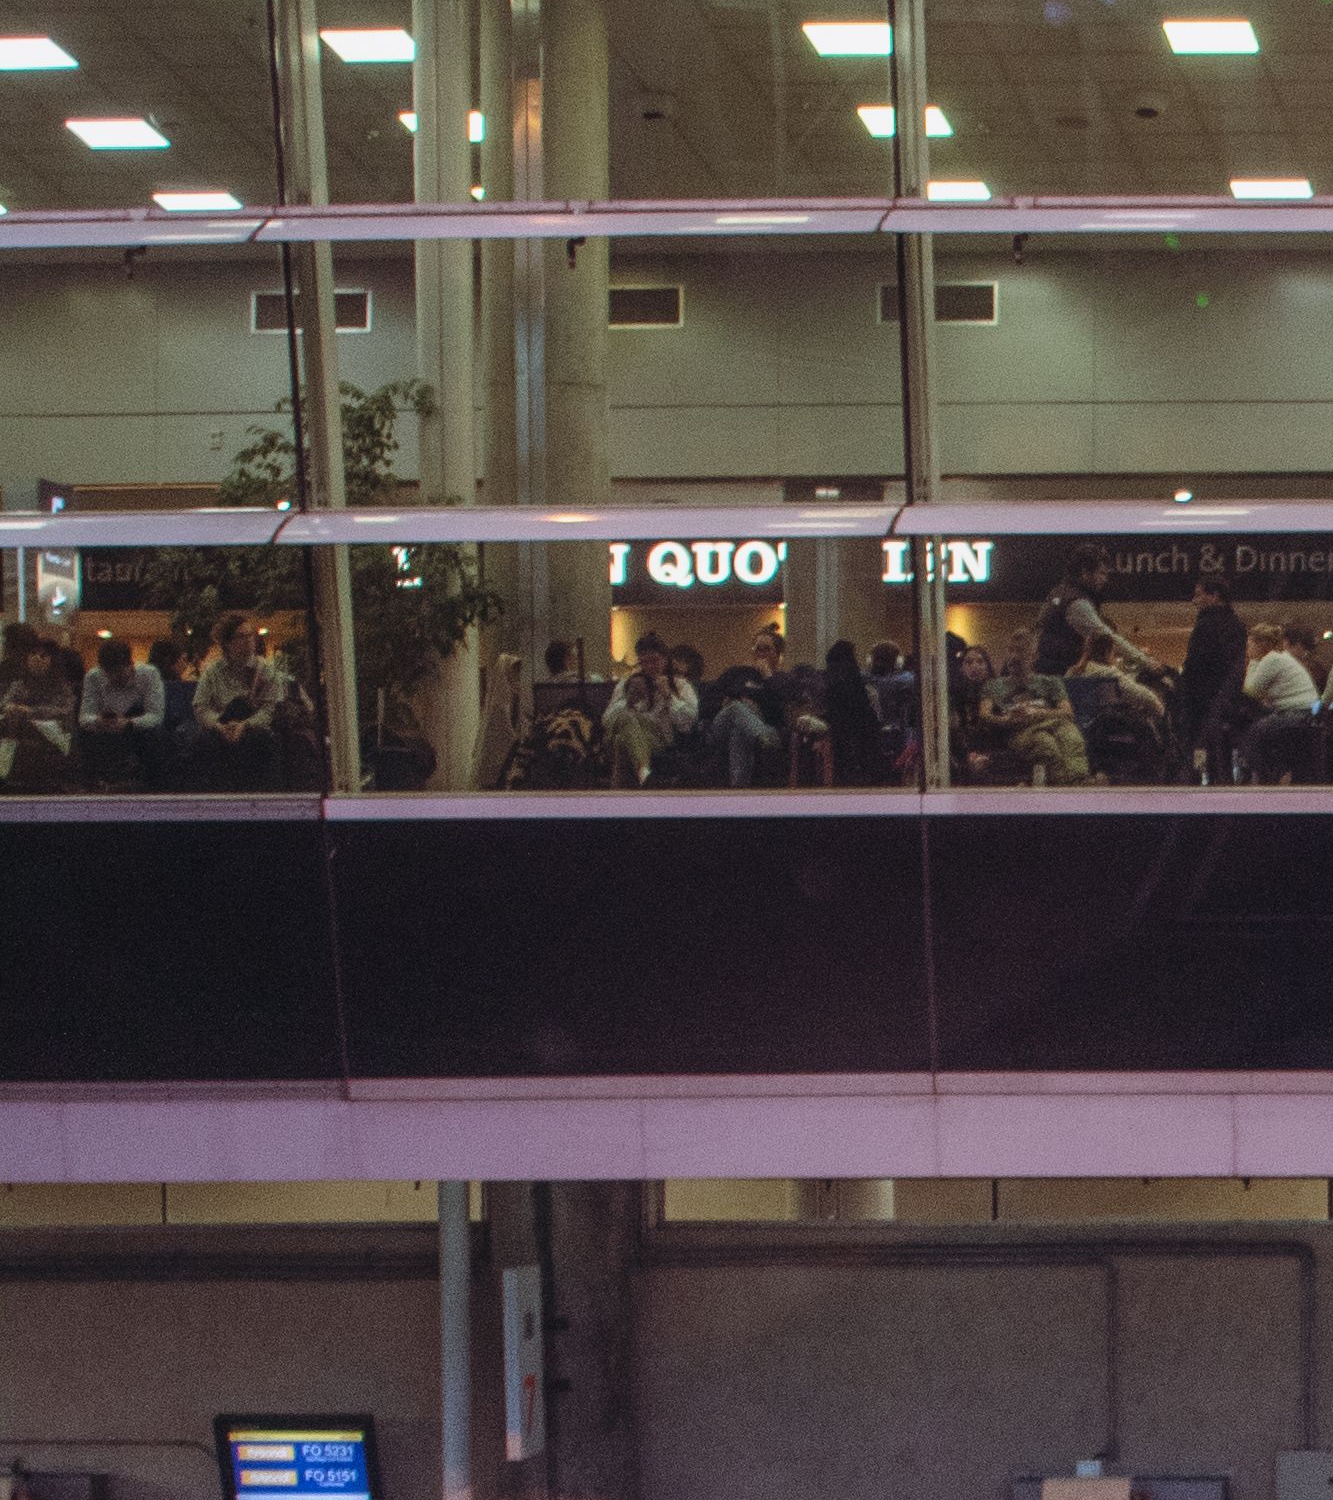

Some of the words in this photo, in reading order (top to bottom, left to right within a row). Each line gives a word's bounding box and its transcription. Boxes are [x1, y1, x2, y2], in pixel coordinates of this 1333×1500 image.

[1199, 544, 1223, 573] &
[302, 1444, 322, 1457] FO
[304, 1470, 324, 1482] FO
